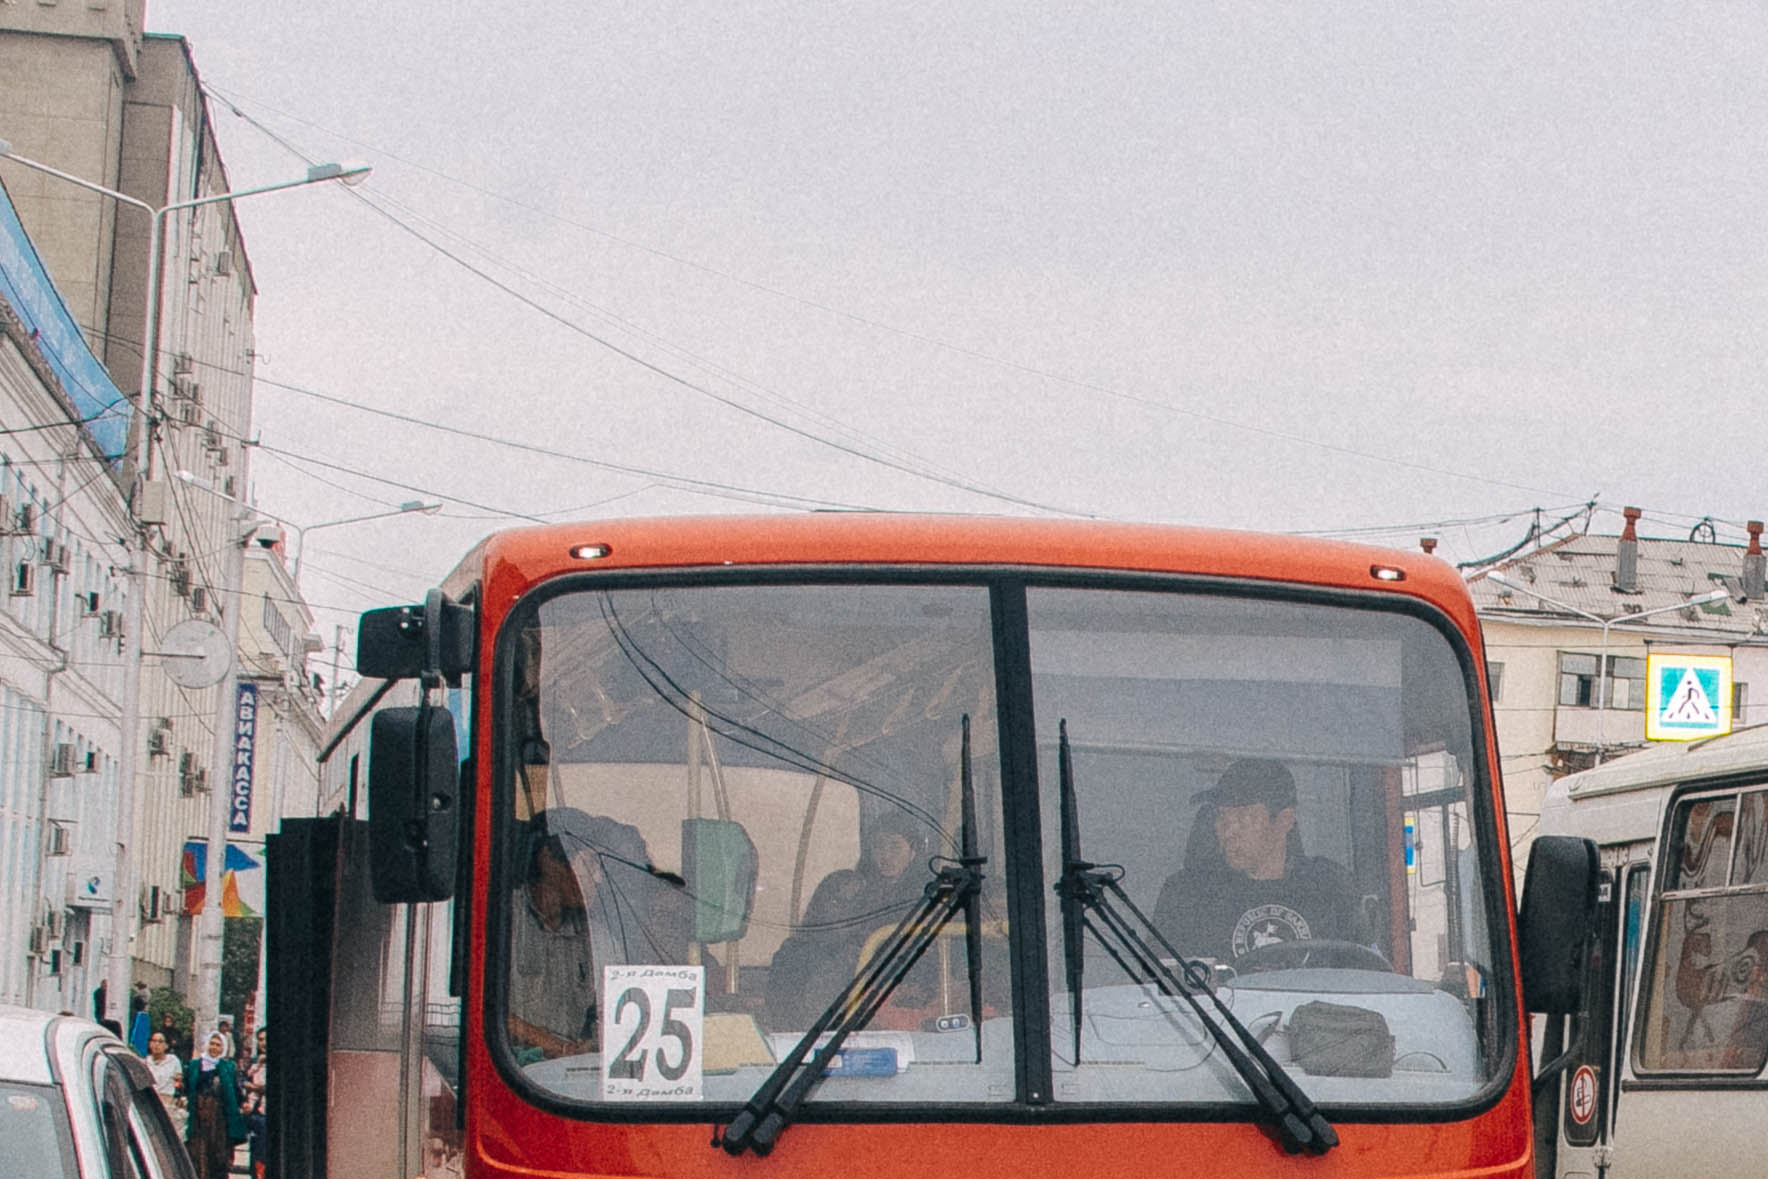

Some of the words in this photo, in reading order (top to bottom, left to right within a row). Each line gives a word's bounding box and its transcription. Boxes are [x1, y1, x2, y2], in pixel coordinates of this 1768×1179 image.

[232, 691, 255, 826] АВИАКАССА
[639, 969, 697, 981] Дамба
[608, 986, 697, 1082] 25
[607, 1084, 633, 1096] 2-я
[636, 1086, 694, 1098] Дамба
